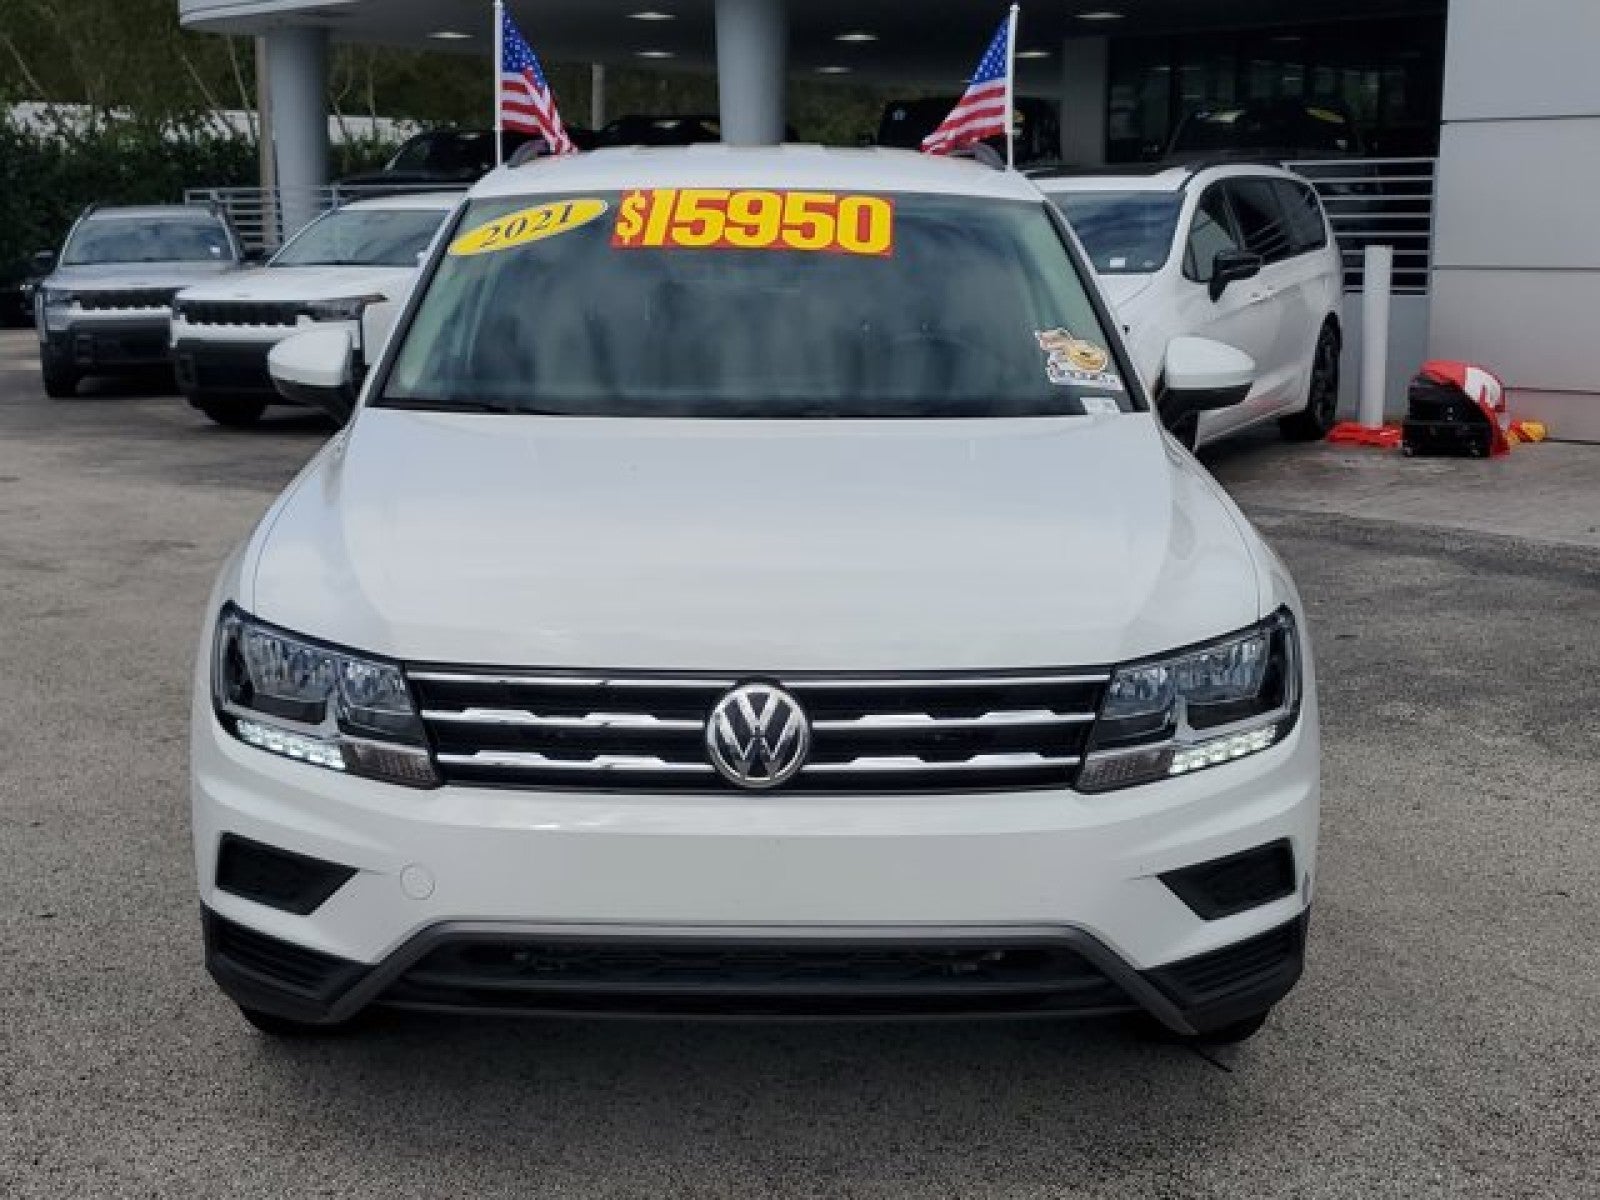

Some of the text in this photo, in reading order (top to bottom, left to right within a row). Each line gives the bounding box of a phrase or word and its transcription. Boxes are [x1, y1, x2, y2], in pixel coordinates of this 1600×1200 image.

[480, 202, 573, 248] 2021
[616, 189, 891, 254] $15950
[710, 687, 806, 783] VW
